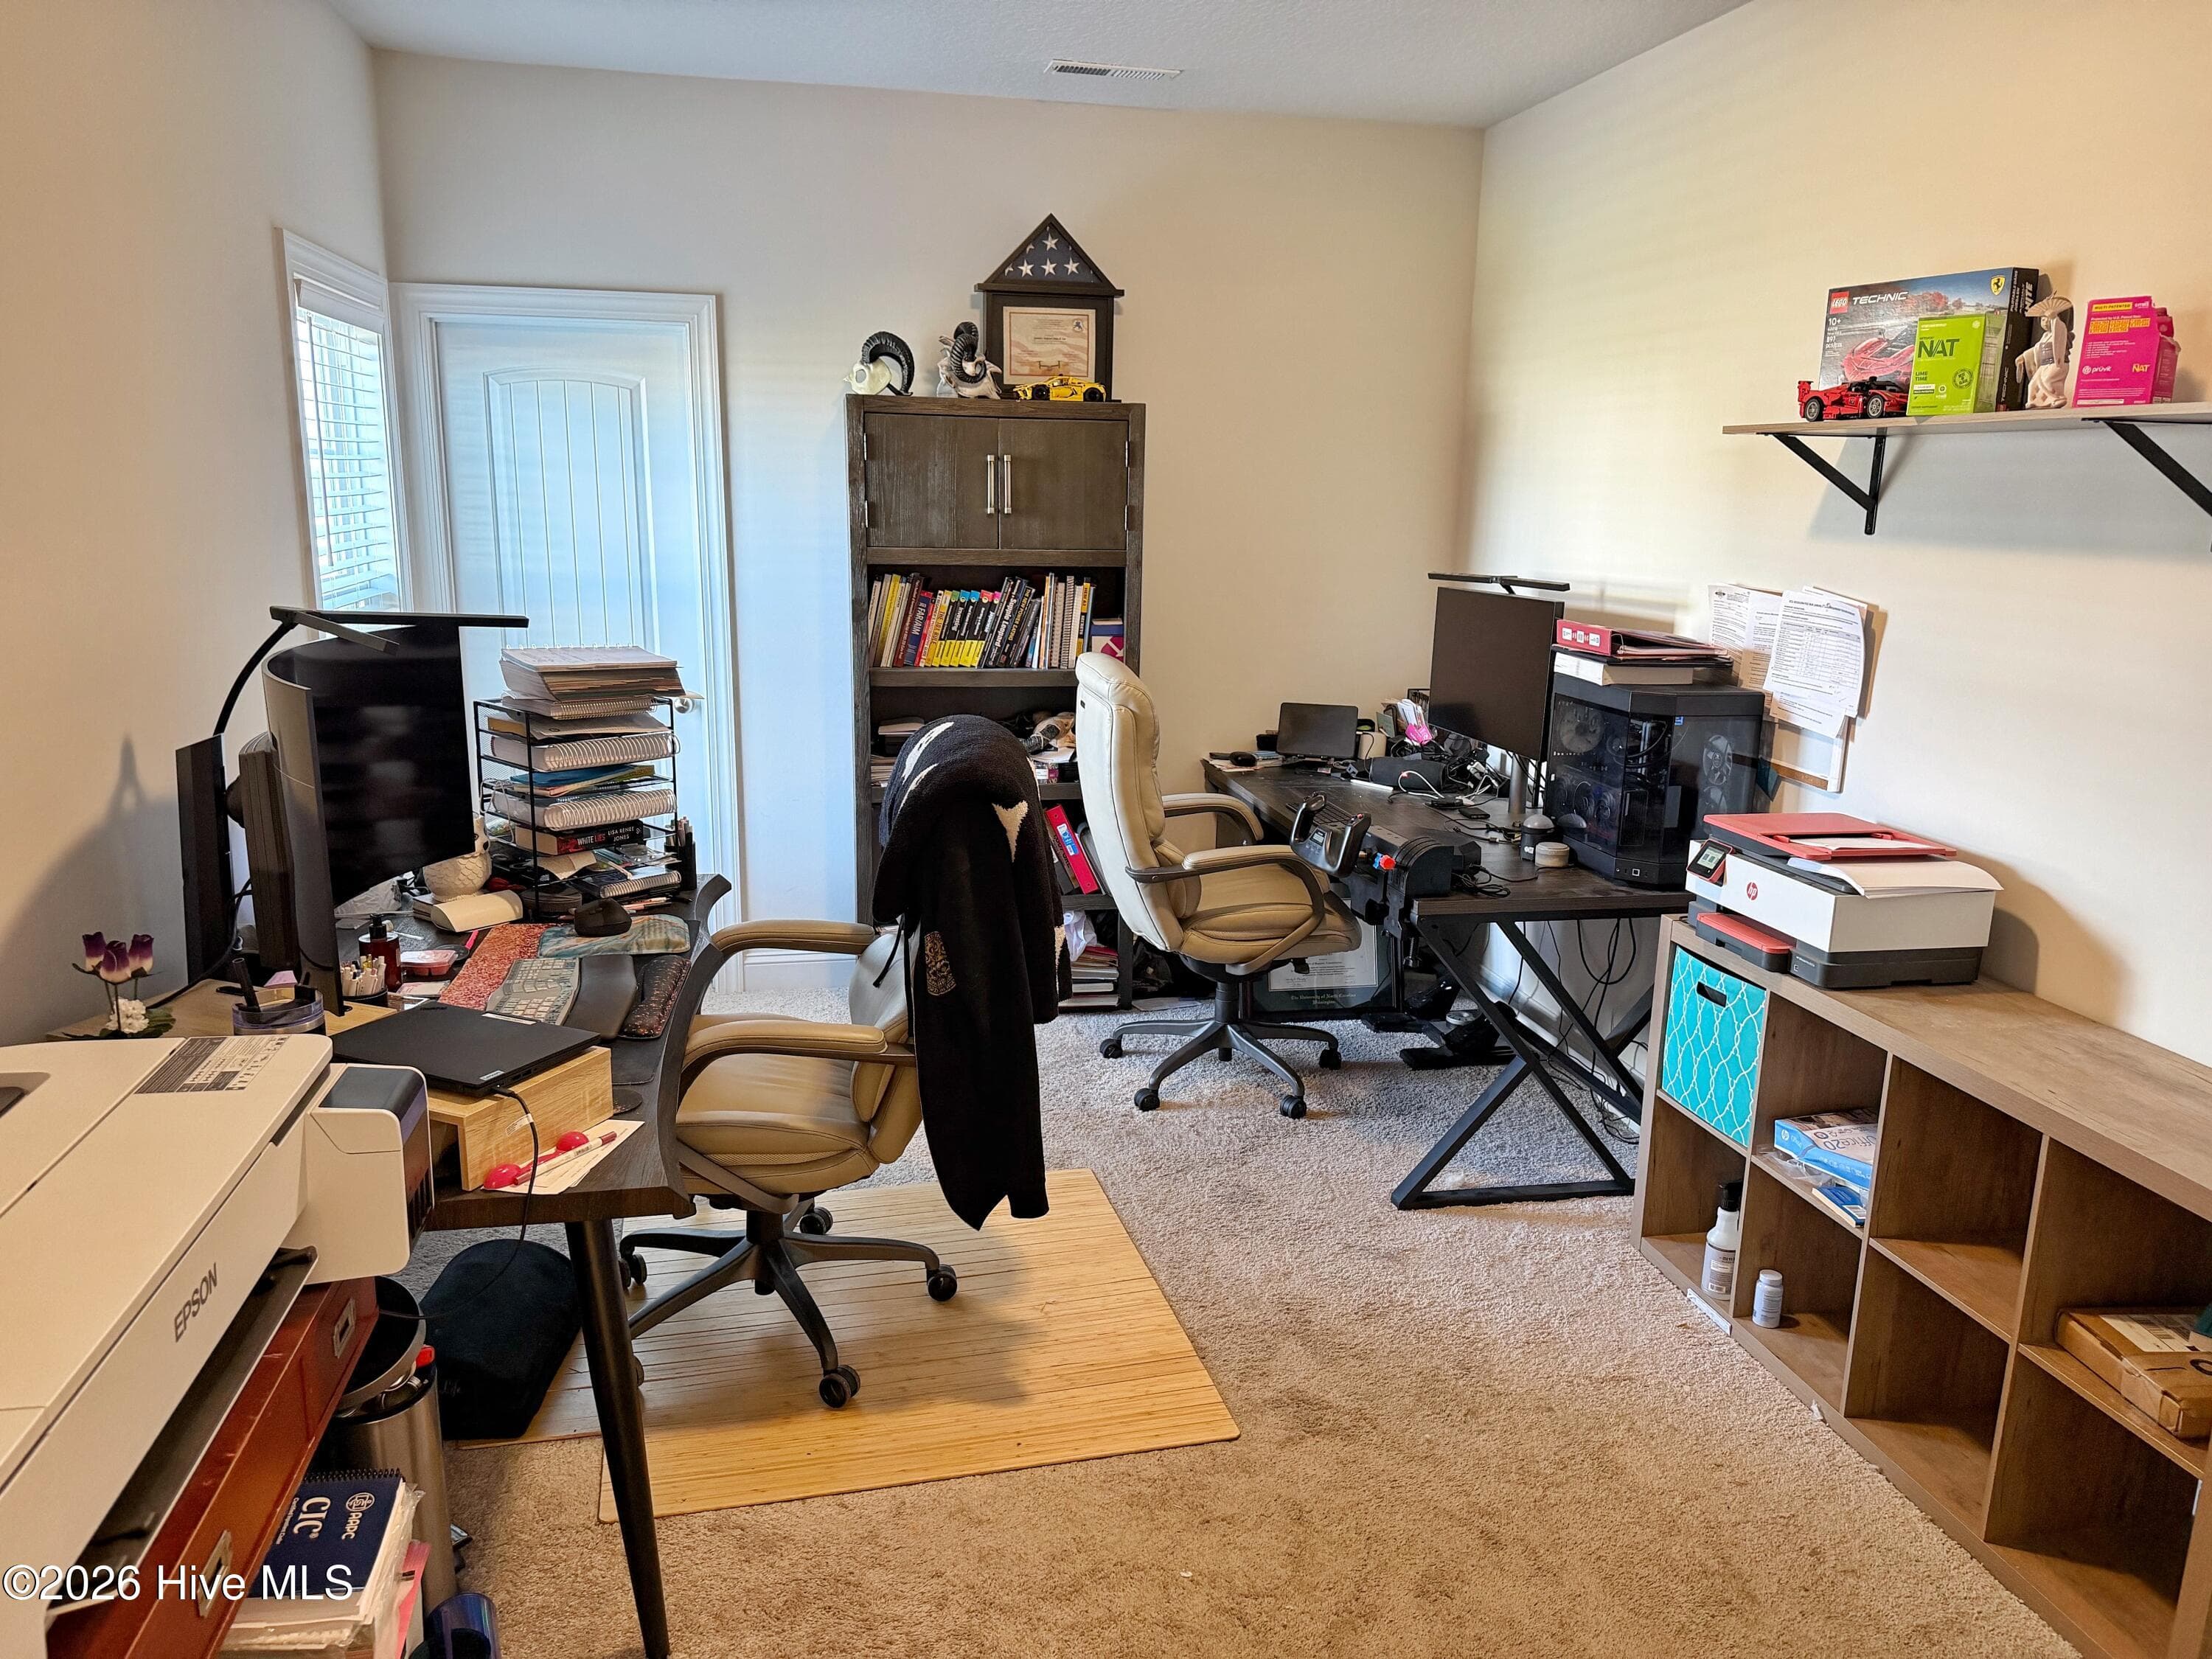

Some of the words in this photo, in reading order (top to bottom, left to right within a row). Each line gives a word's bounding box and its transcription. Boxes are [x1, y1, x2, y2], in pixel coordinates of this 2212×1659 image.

[1832, 297, 1848, 307] LEGO
[1852, 291, 1909, 305] TECHNIC
[1829, 318, 1841, 326] 10+
[1918, 338, 1960, 358] NAT
[2132, 364, 2150, 372] NAT
[952, 607, 964, 631] Investing
[1004, 598, 1017, 620] Supple
[1015, 605, 1025, 625] POWER
[911, 607, 926, 635] FAR/AIM
[995, 620, 1009, 647] Leopard
[1008, 624, 1018, 641] EATING
[577, 835, 594, 845] WHITE
[594, 834, 605, 842] LIES
[1747, 882, 1759, 900] hp
[174, 1263, 218, 1343] EPSON
[341, 1512, 363, 1540] AAPC
